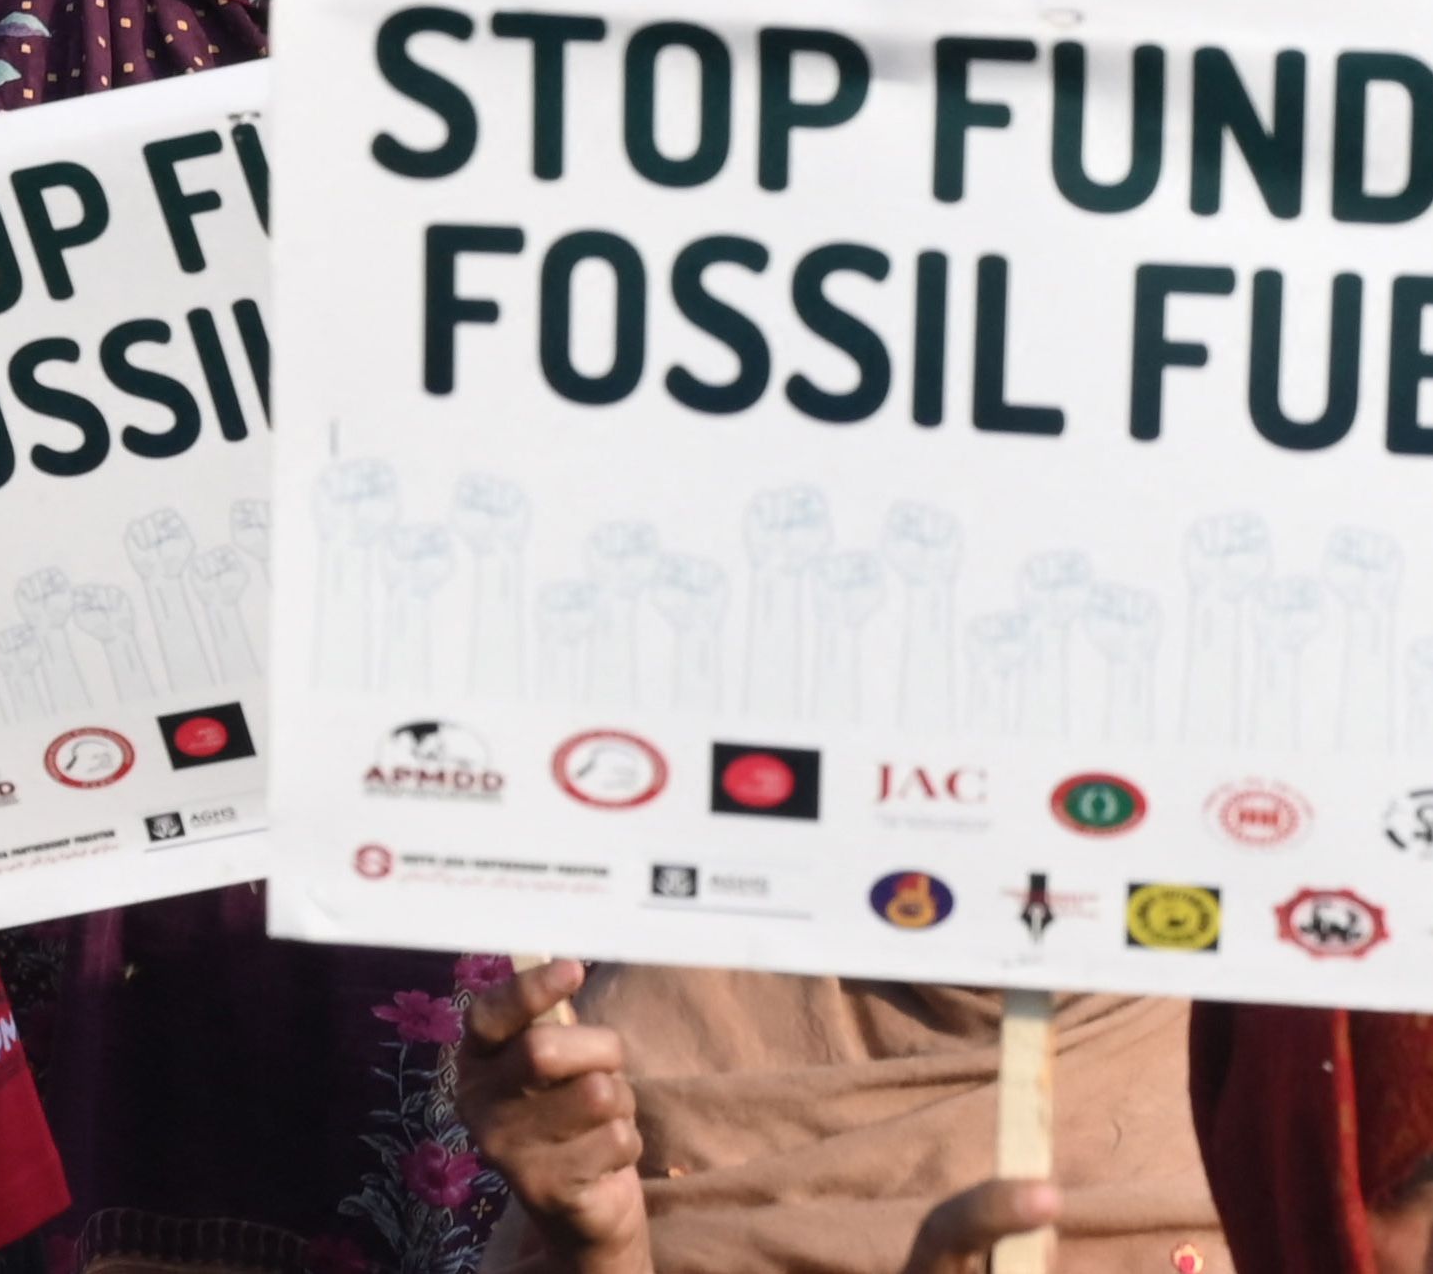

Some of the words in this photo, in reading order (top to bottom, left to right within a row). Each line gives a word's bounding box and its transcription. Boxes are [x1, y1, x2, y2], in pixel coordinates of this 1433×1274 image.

[370, 9, 872, 193] STOP
[423, 223, 1066, 424] FOSSIL
[875, 763, 989, 805] JAC
